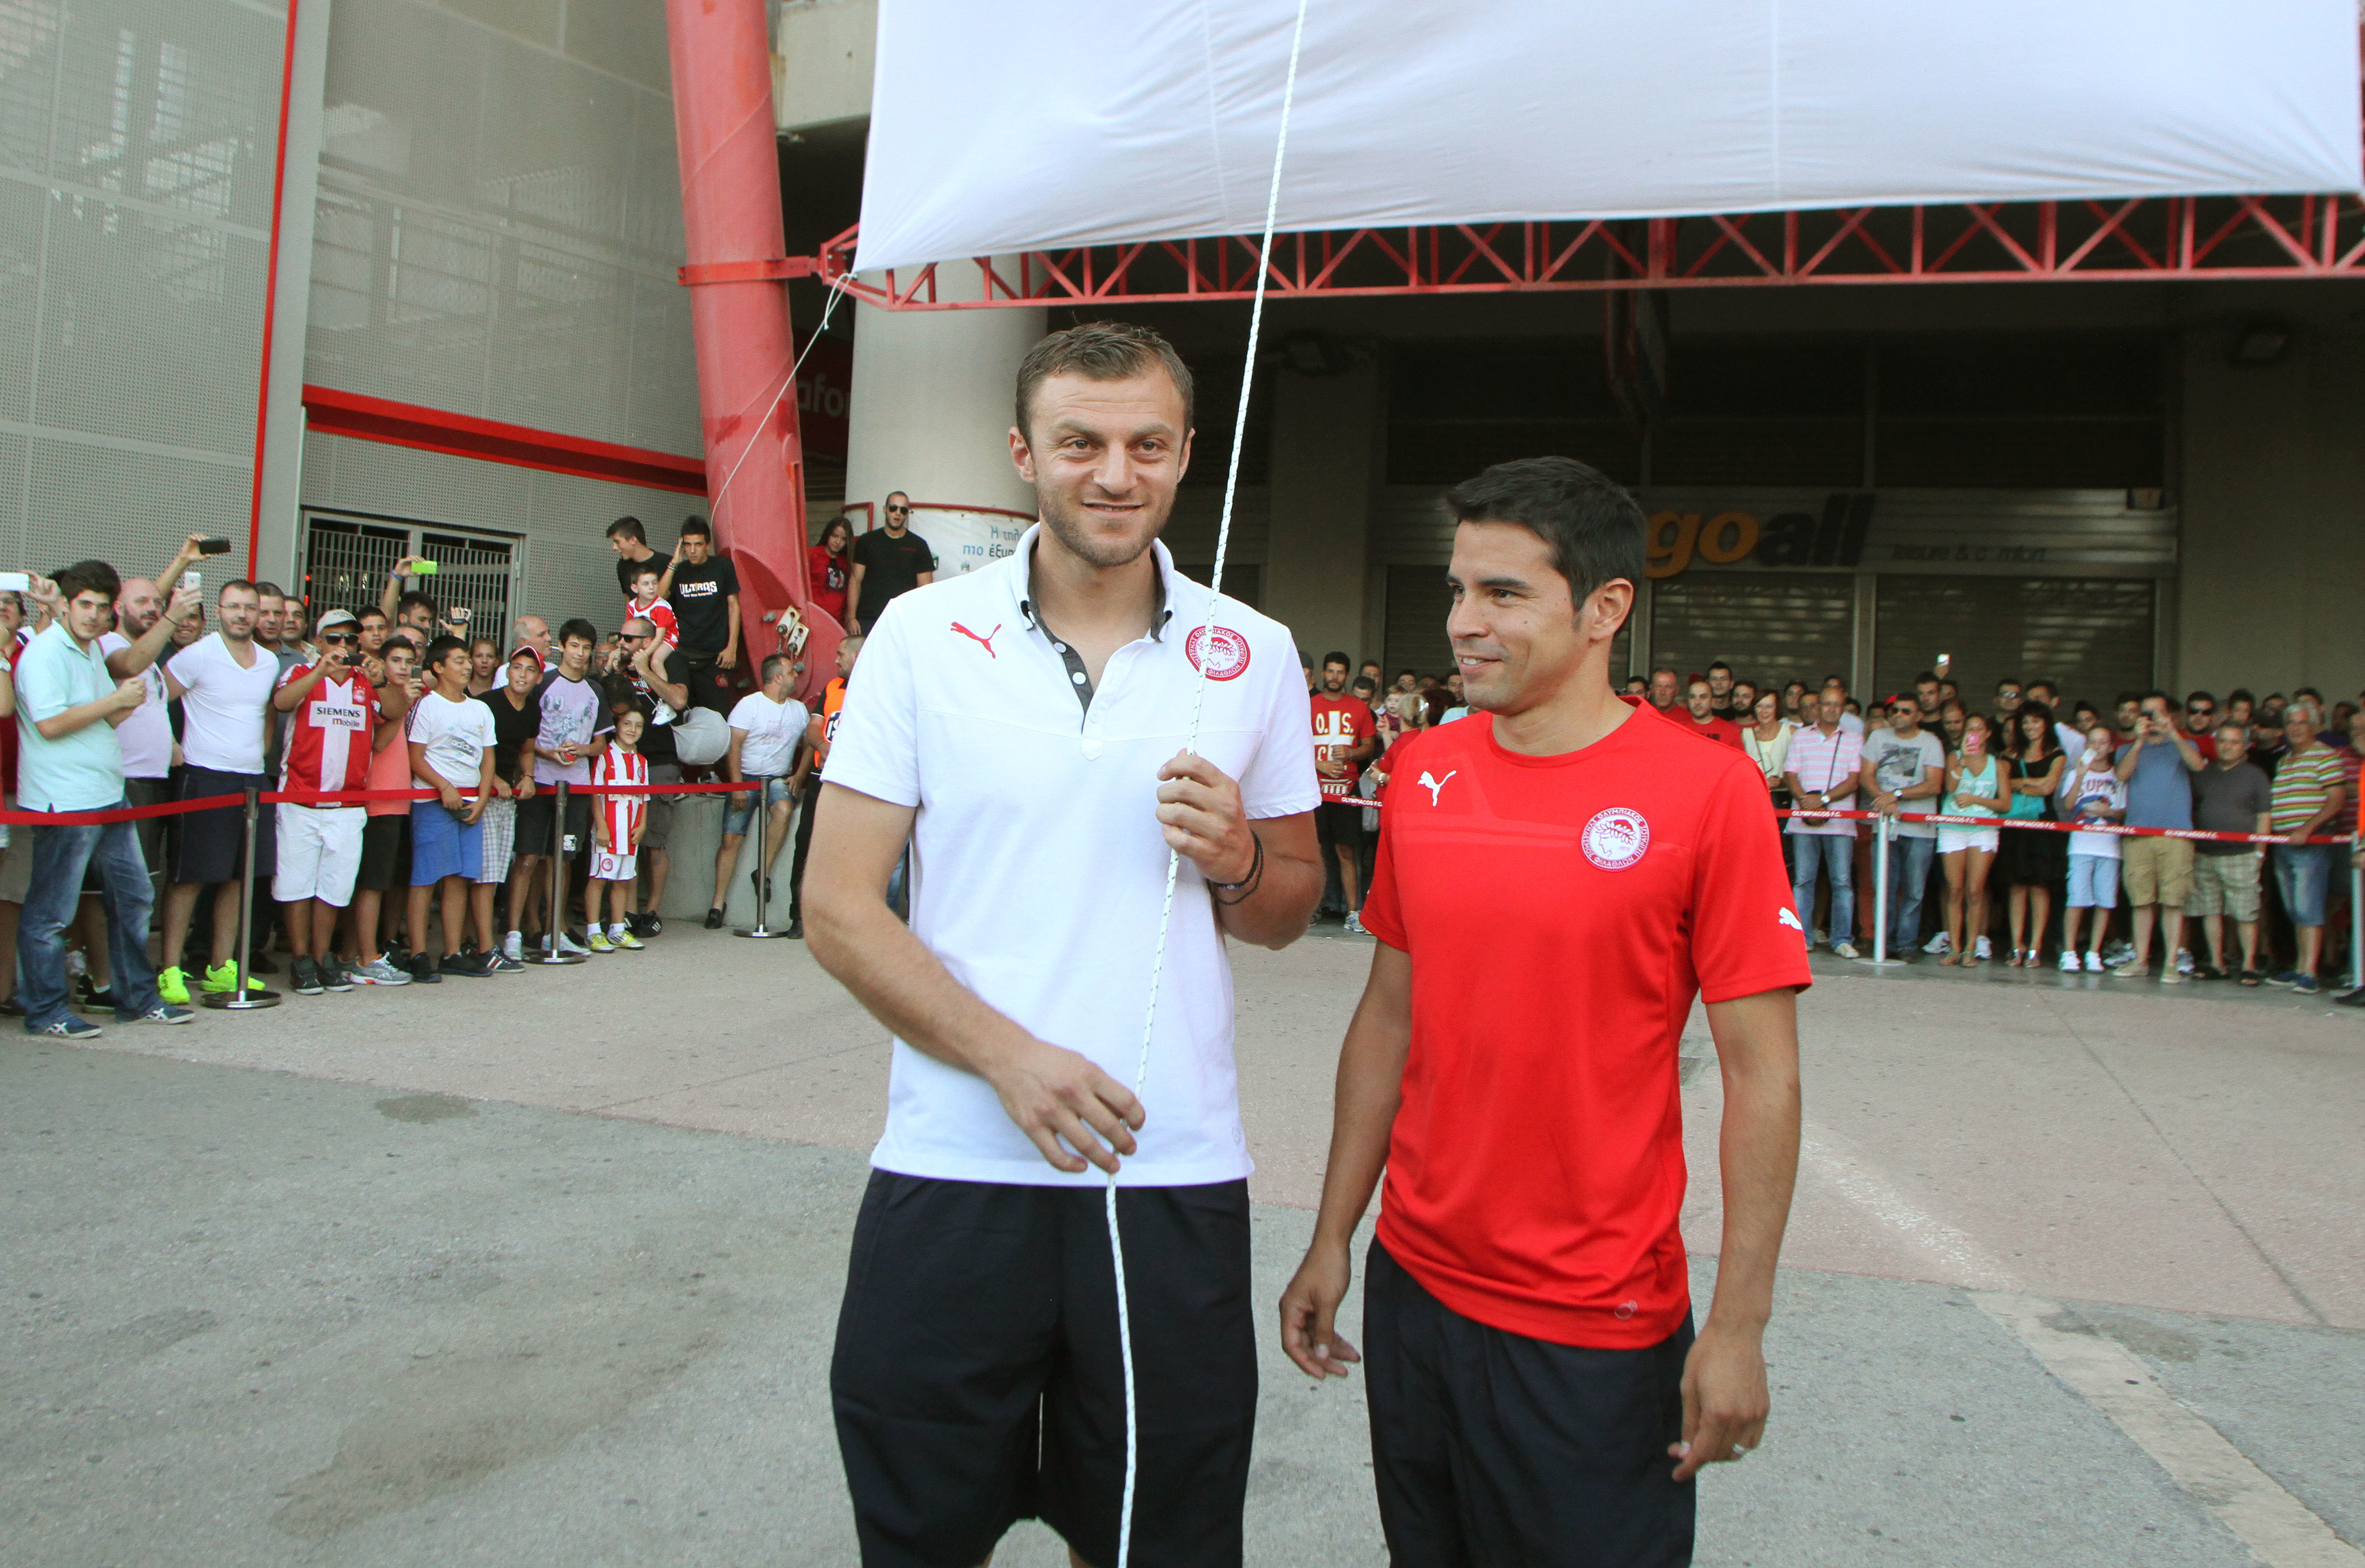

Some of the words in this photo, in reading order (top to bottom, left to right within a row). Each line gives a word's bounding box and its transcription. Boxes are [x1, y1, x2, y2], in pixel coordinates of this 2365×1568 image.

[679, 581, 718, 595] ULTRAS
[317, 707, 360, 718] SIEMENS
[1341, 797, 1374, 806] OLYMPIACOS
[1597, 809, 1643, 824] ΟΛΥΜΠΙΑΚΟΣ
